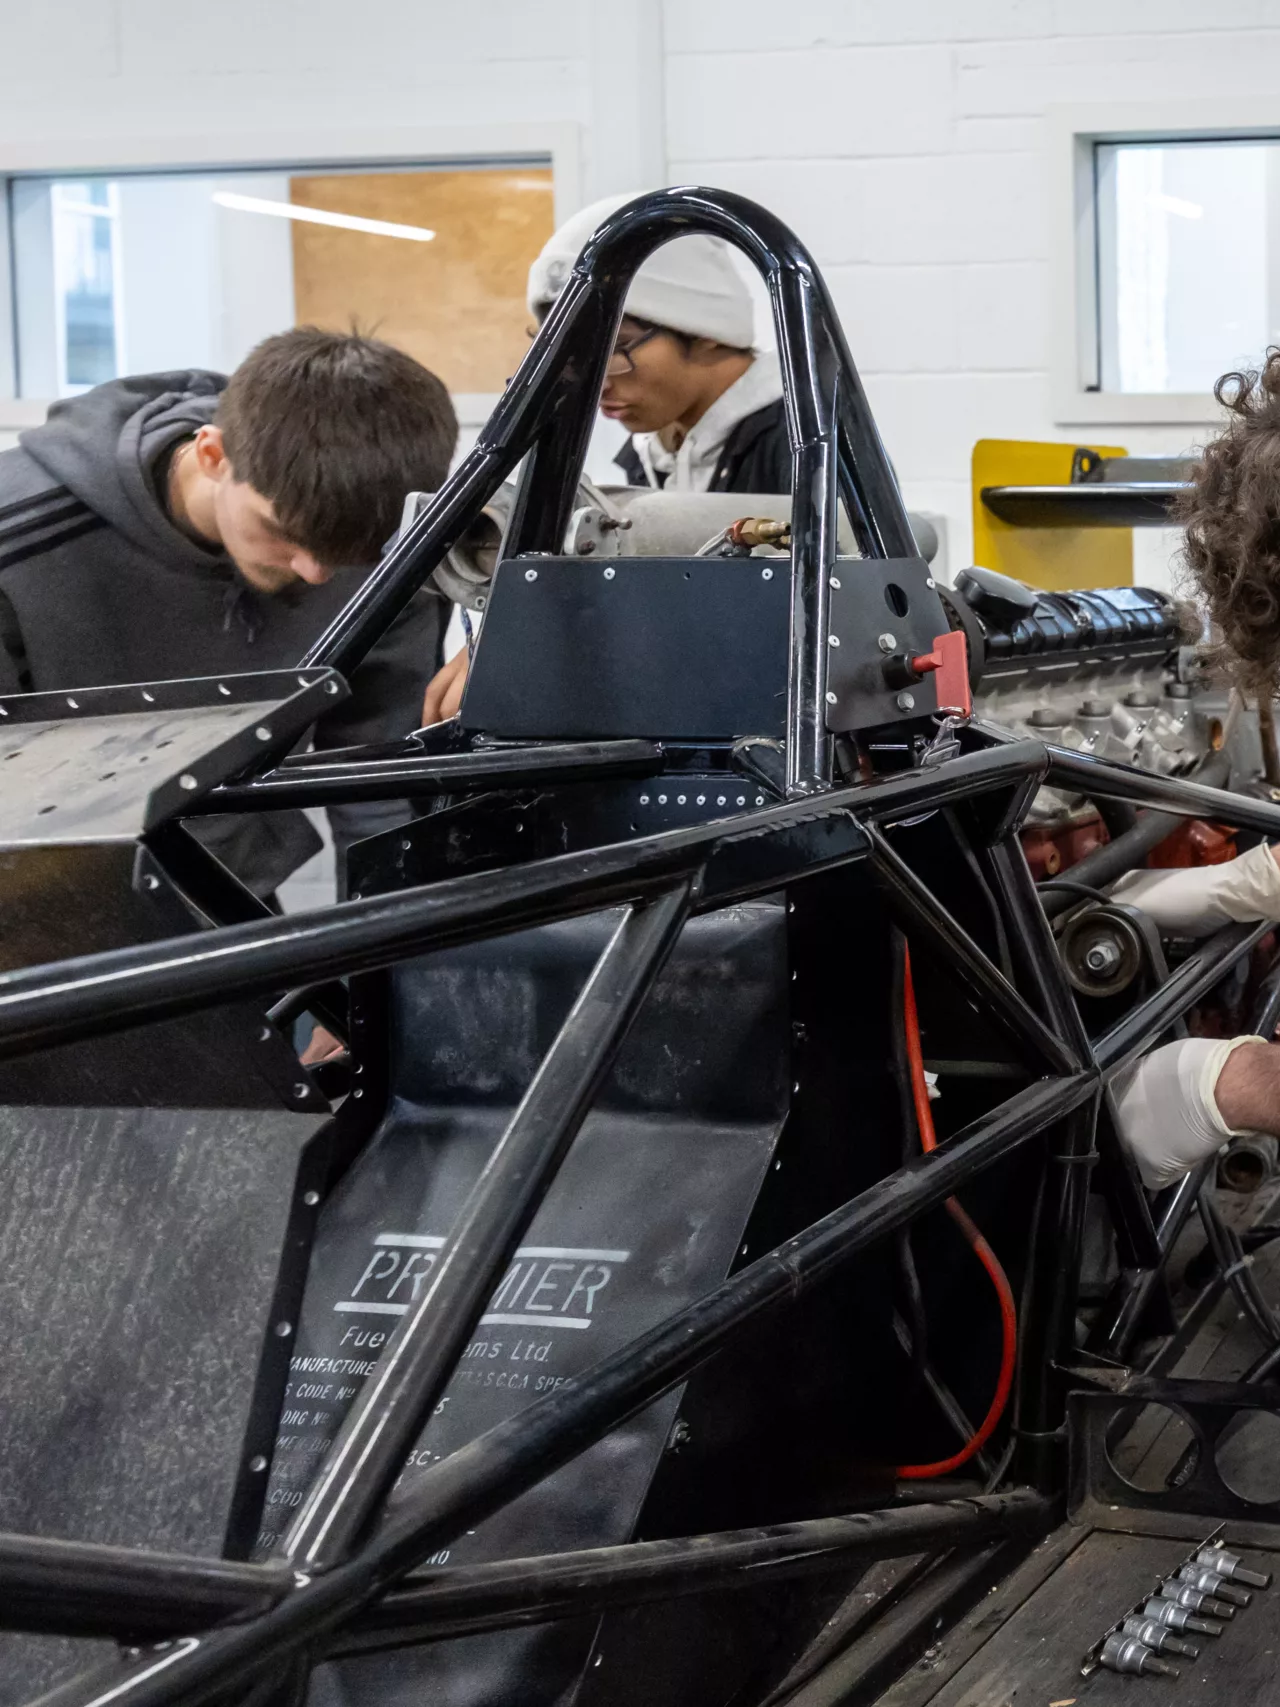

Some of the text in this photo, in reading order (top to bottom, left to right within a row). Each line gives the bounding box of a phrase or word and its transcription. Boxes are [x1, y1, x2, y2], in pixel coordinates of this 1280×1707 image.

[351, 1251, 612, 1314] PRMIER
[510, 1339, 552, 1362] Ltd.
[296, 1383, 333, 1399] CODE
